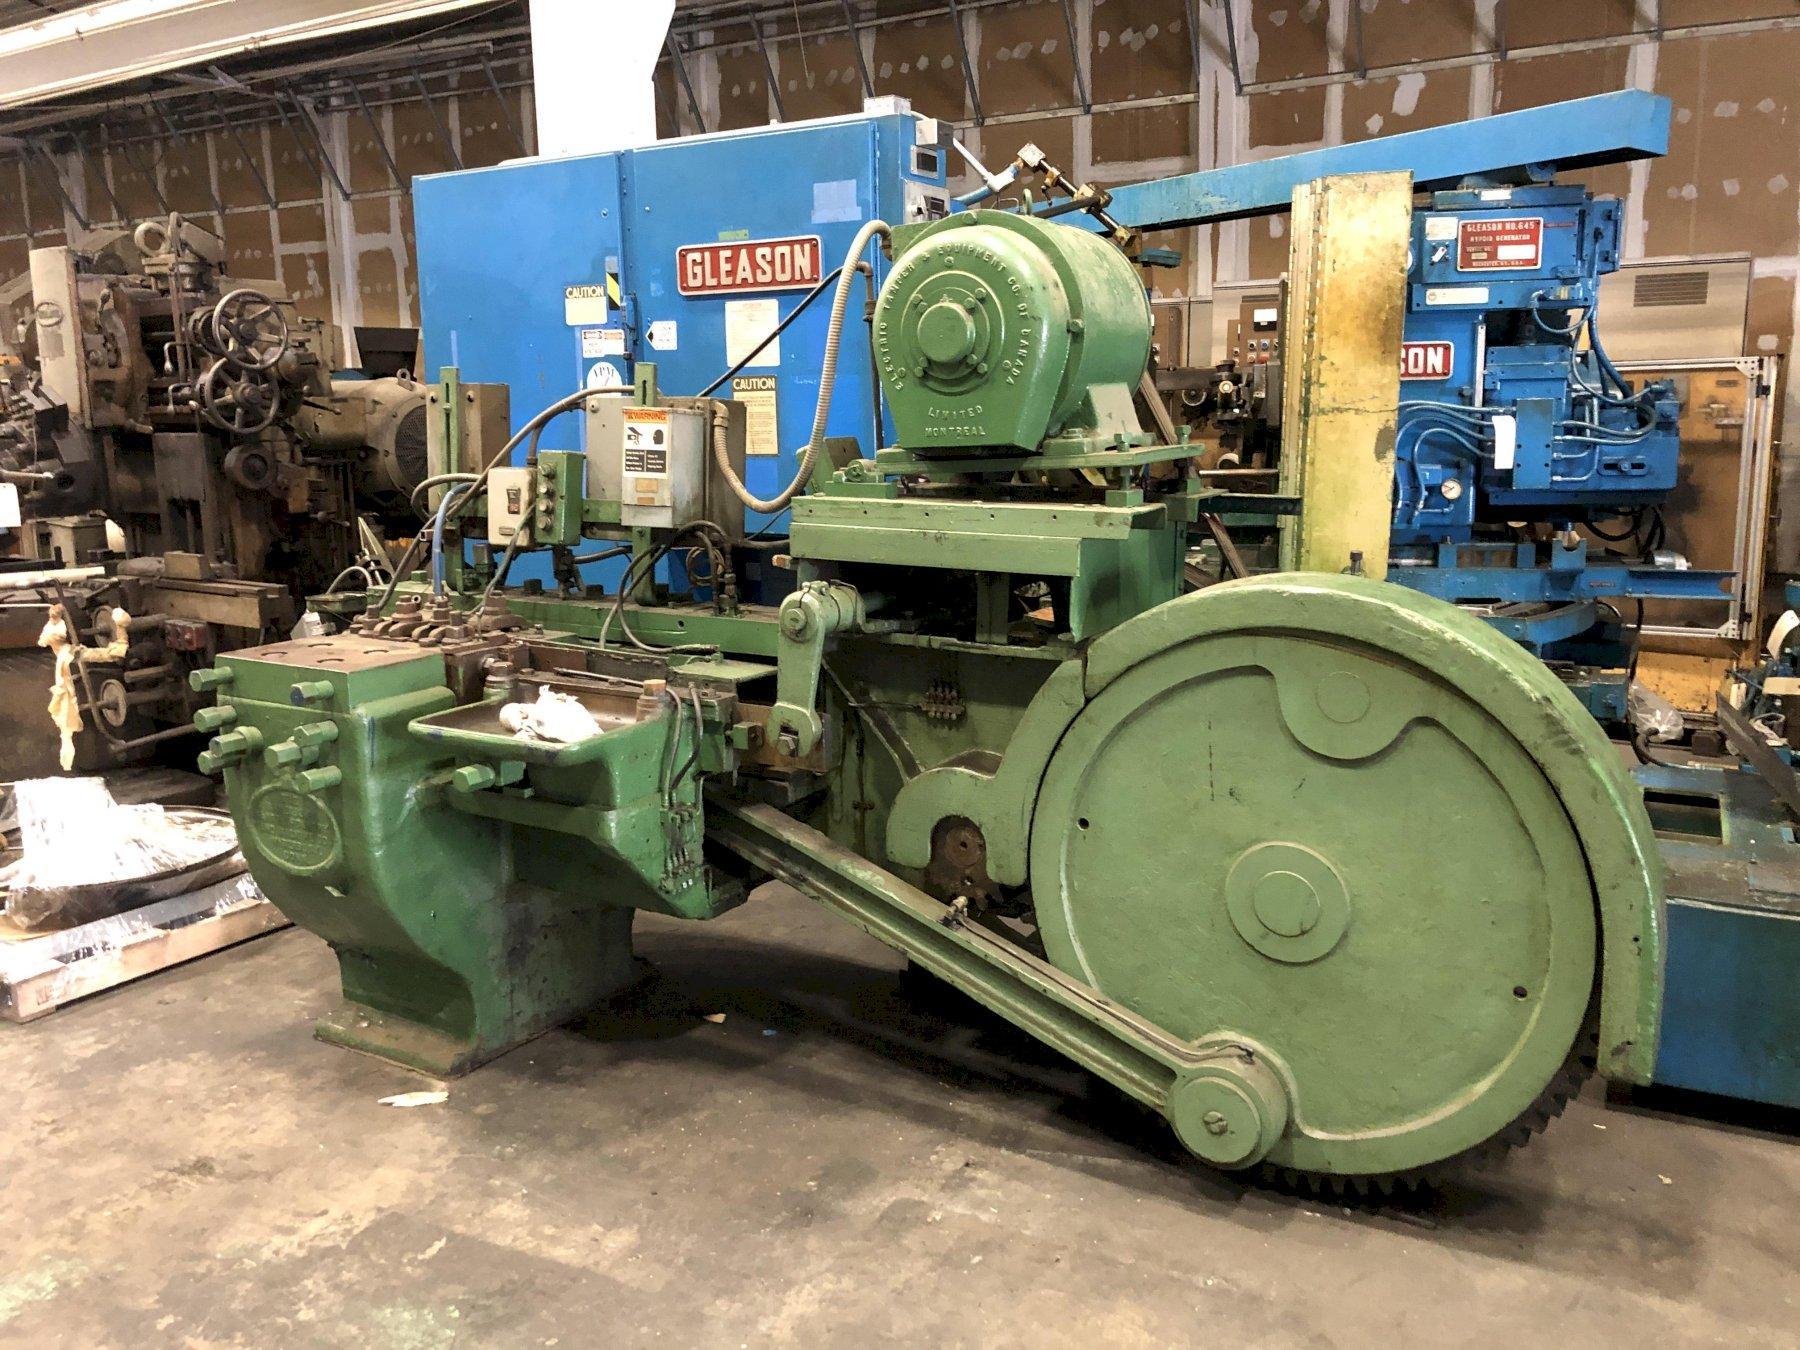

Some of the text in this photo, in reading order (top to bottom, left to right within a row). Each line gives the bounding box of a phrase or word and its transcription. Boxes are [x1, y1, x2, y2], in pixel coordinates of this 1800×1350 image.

[1467, 223, 1502, 232] GLEASON
[686, 243, 812, 288] GLEASON
[566, 286, 604, 298] CAUTION
[938, 243, 1007, 272] EQUIPMENT
[1005, 328, 1032, 386] CANADA
[733, 378, 776, 390] CAUTION
[928, 405, 983, 419] LIMITED
[925, 425, 986, 437] MONTREAL
